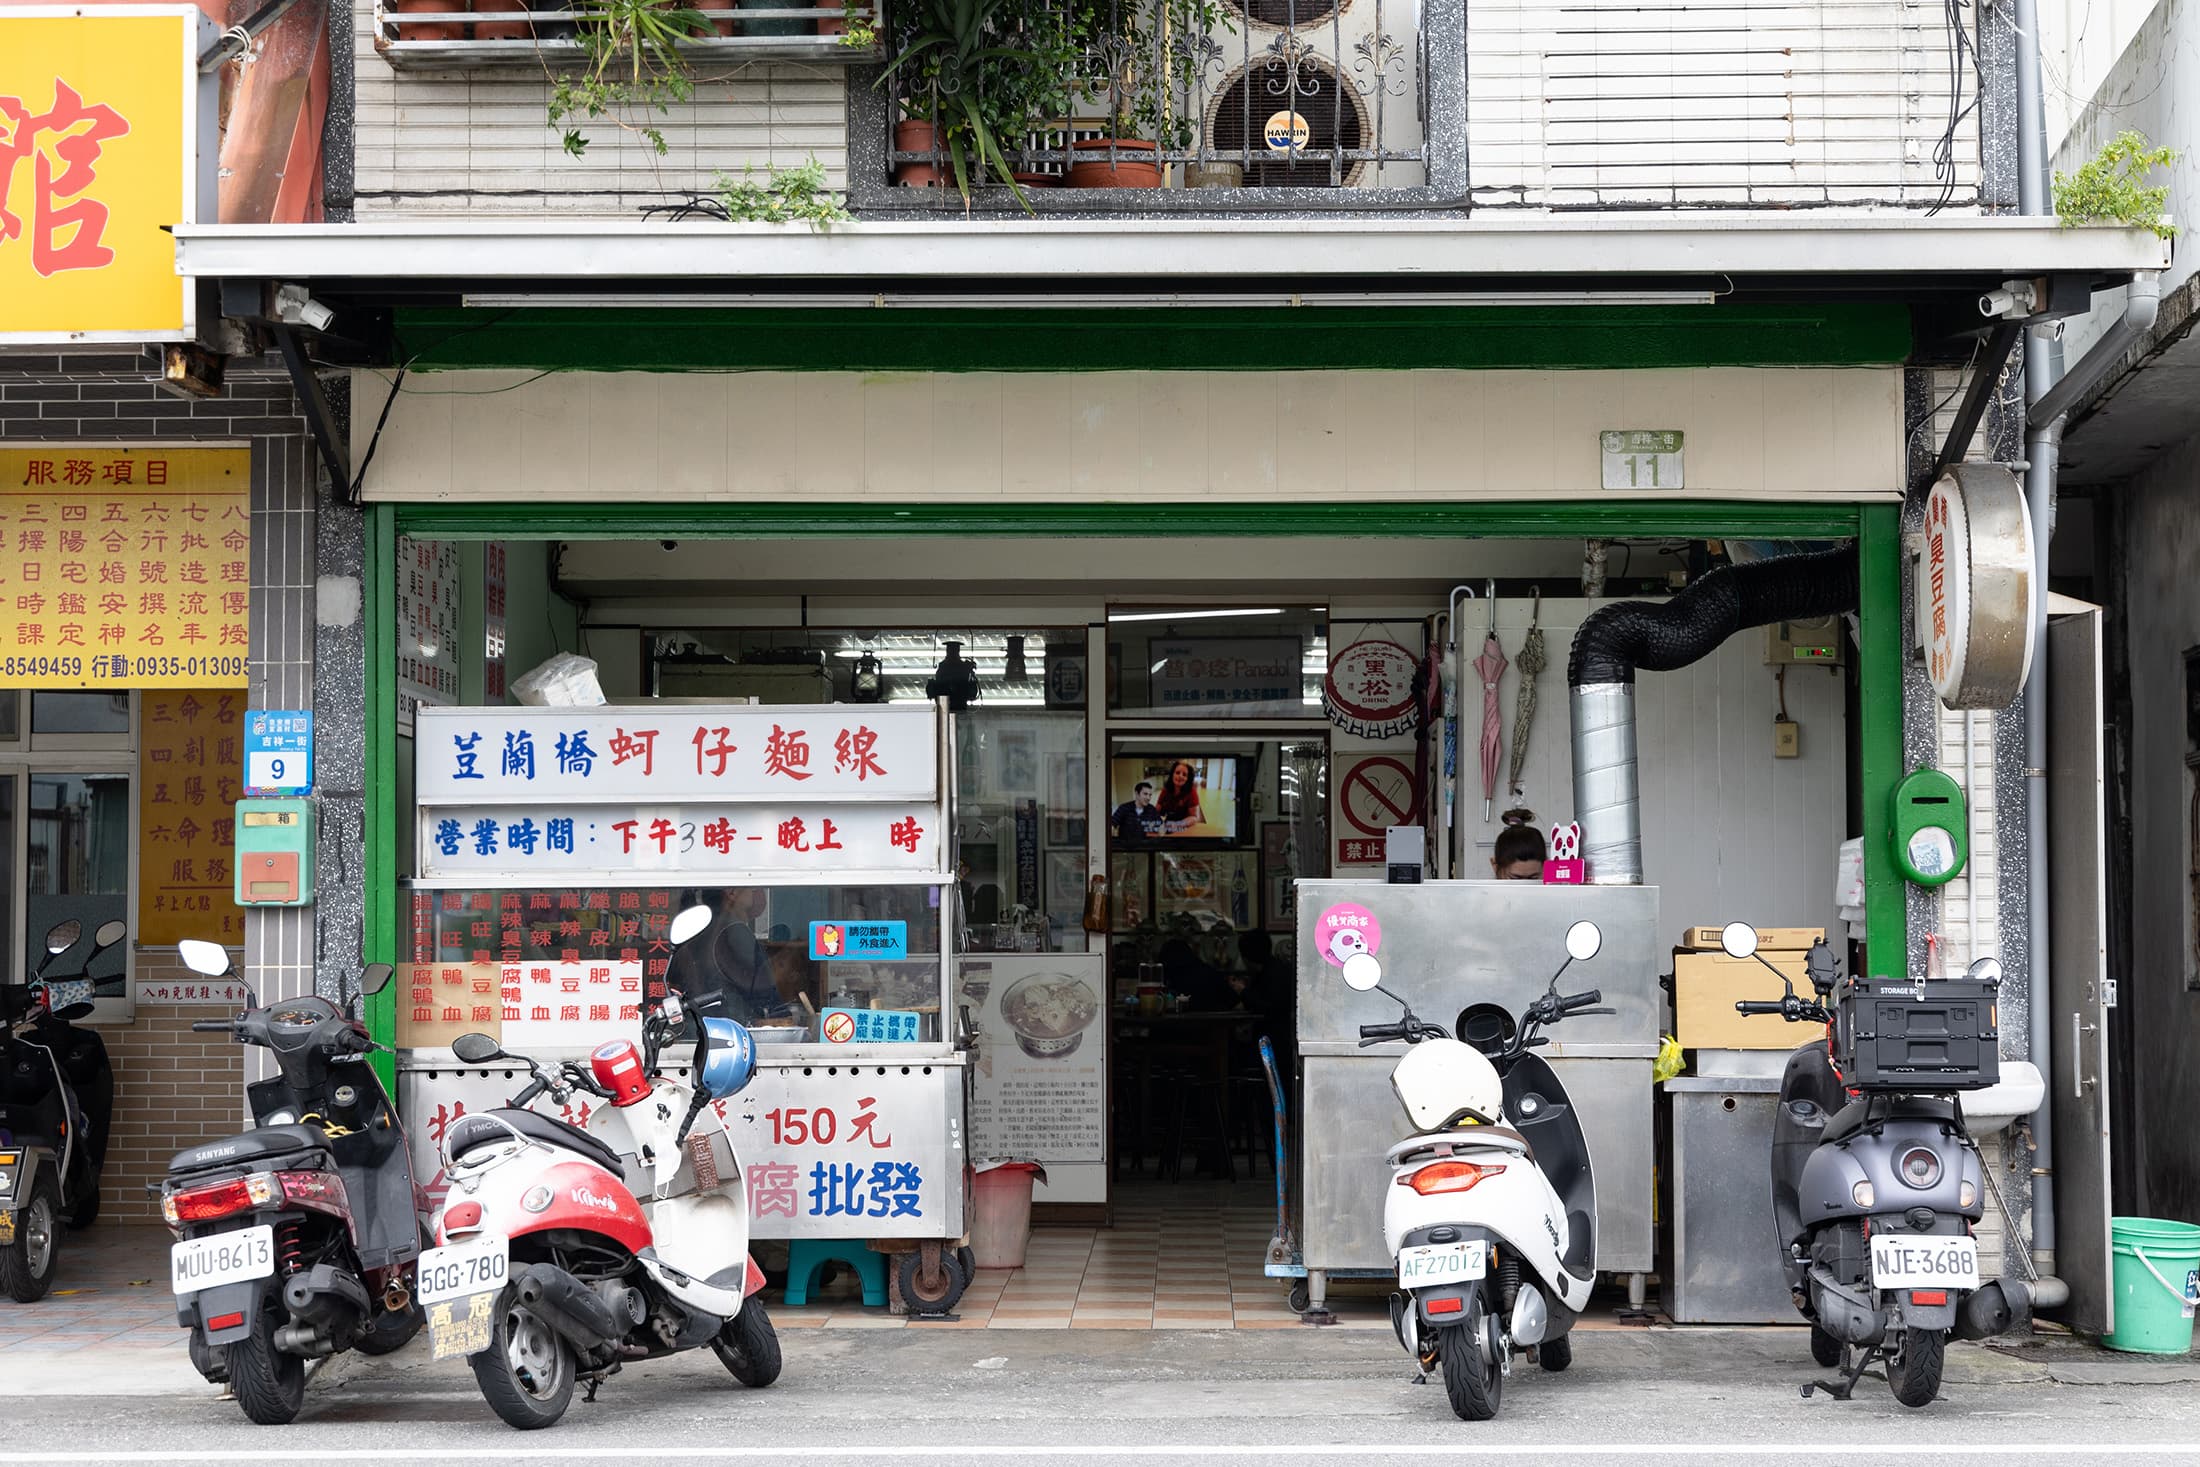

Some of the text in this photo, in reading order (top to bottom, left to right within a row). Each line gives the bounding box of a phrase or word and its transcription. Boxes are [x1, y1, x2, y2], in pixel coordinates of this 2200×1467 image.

[26, 459, 169, 487] 服務項目
[1624, 454, 1659, 487] 11
[1358, 659, 1392, 696] 黑松
[271, 759, 285, 780] 9
[1346, 842, 1387, 860] 禁止
[859, 937, 900, 949] 外食進入
[1880, 987, 1908, 995] STORAGE
[195, 1145, 236, 1162] SANYANG
[1403, 1250, 1482, 1278] AF27012
